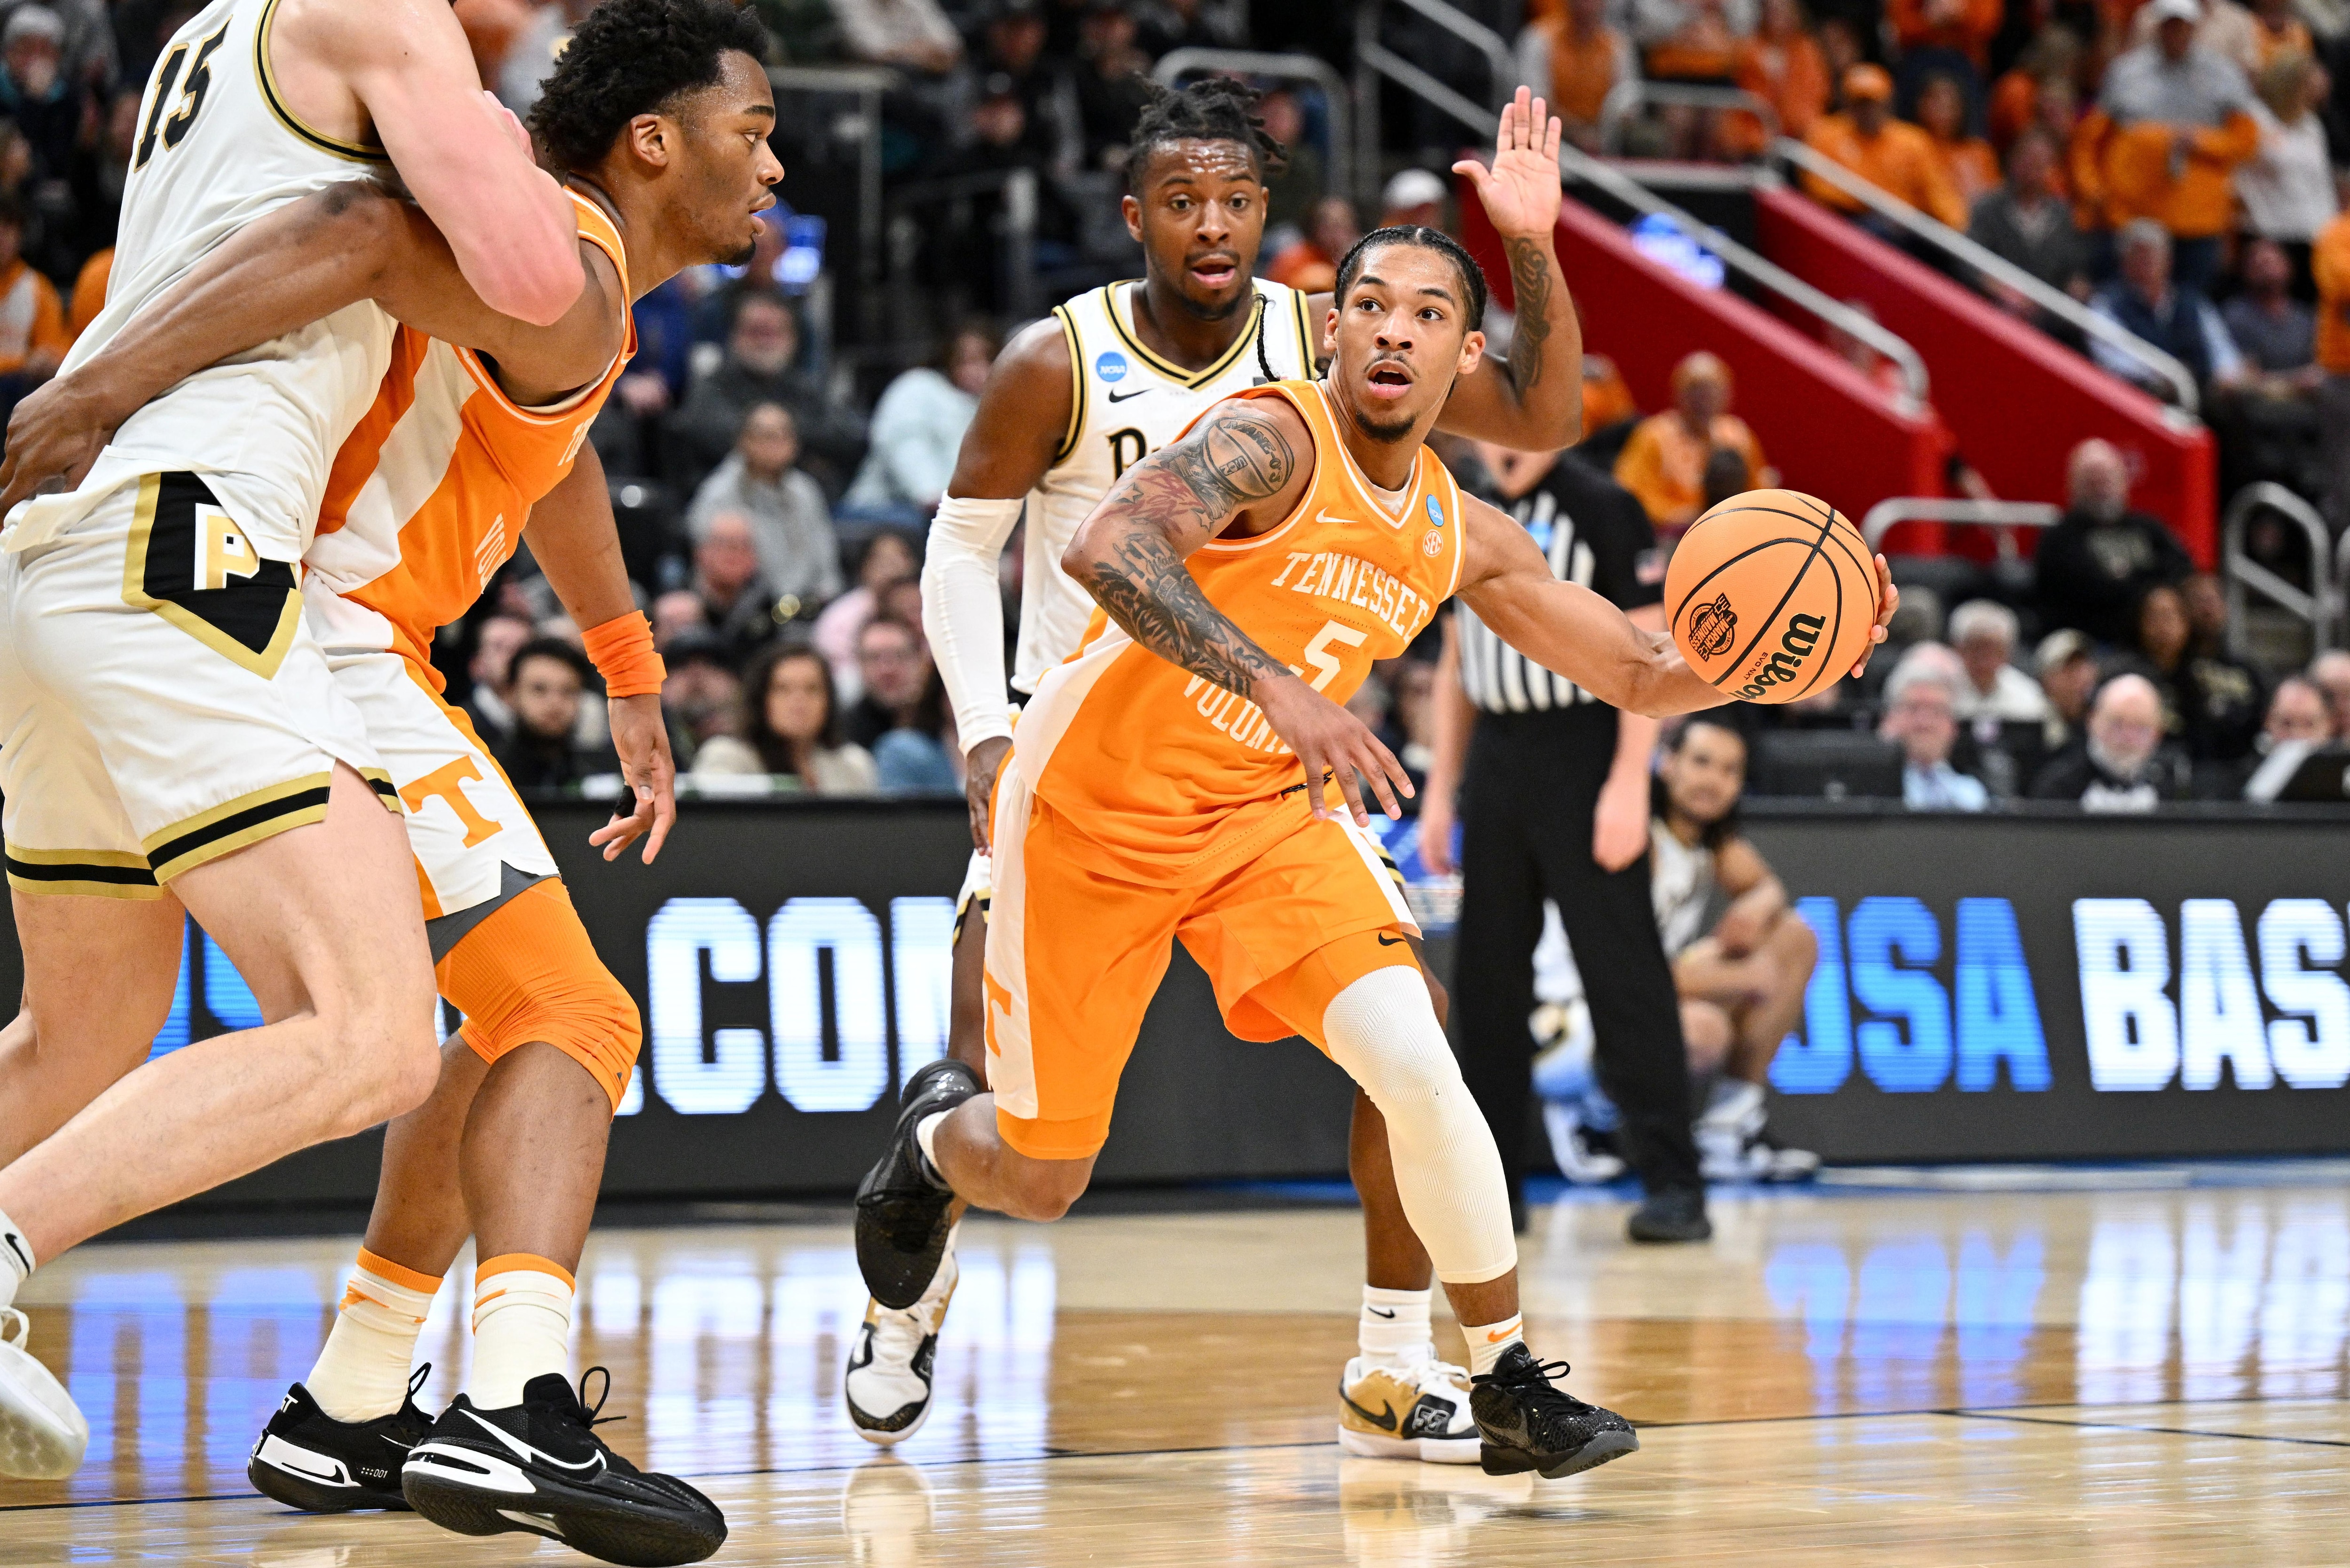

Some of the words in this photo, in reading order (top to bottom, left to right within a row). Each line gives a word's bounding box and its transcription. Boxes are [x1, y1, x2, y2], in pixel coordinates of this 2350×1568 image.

[133, 14, 233, 174] 15
[1100, 365, 1125, 374] NCAA
[1425, 531, 1442, 555] SEC
[1270, 552, 1430, 645] TENNESSEE
[1691, 612, 1718, 650] MADNESS
[1704, 618, 1728, 650] MARCH
[1288, 619, 1368, 693] 5
[1728, 614, 1826, 700] Wilson
[1743, 668, 1756, 680] NXT
[1755, 652, 1768, 667] EVO
[398, 755, 503, 849] T
[2071, 898, 2350, 1092] BAS
[373, 1468, 388, 1479] 001
